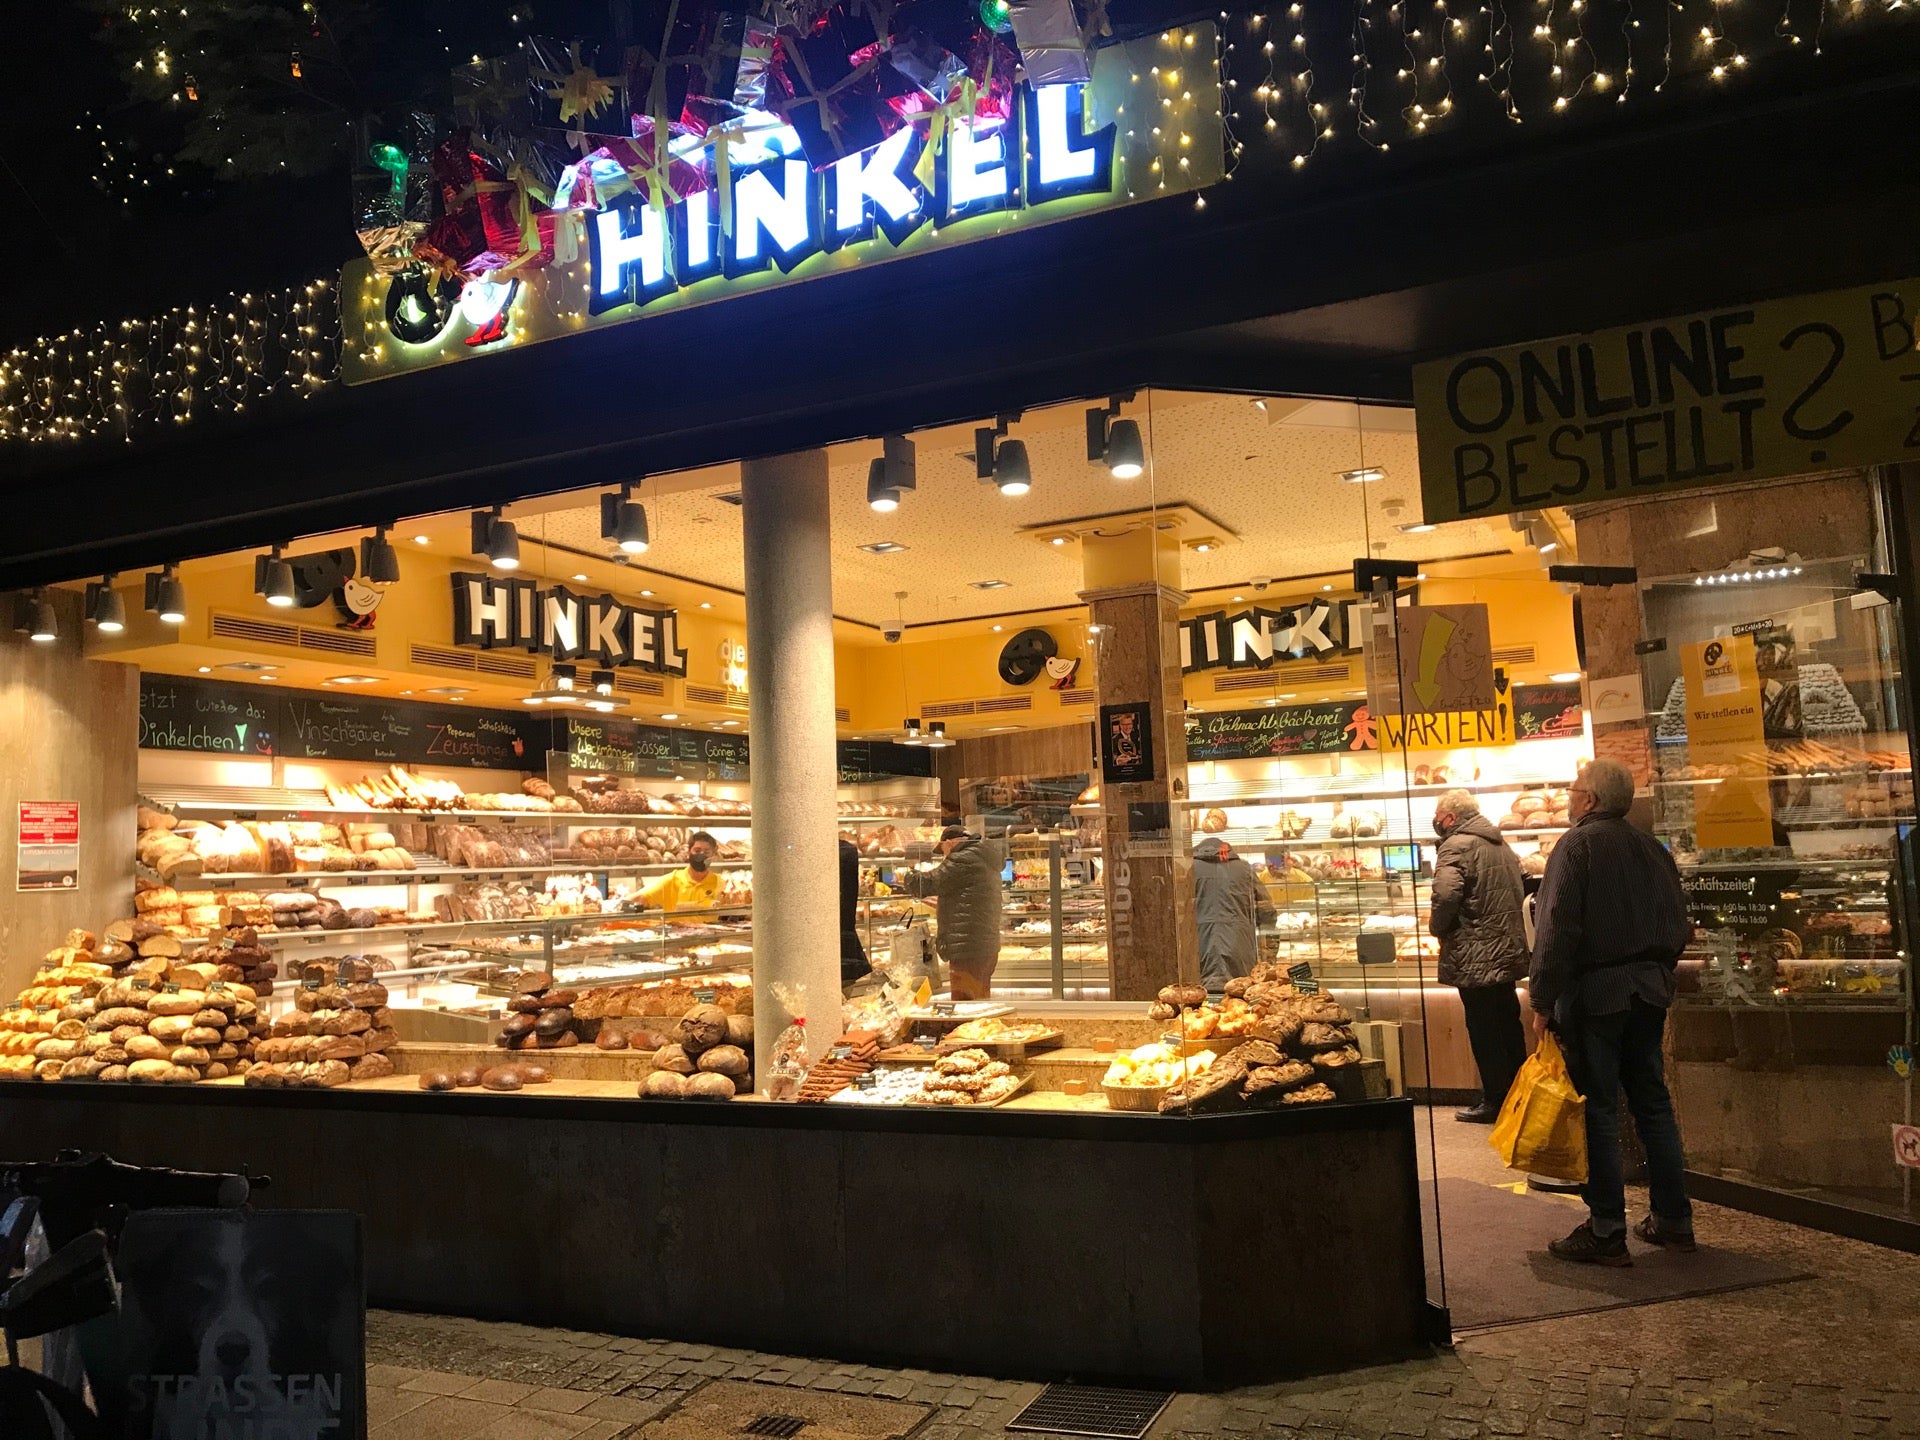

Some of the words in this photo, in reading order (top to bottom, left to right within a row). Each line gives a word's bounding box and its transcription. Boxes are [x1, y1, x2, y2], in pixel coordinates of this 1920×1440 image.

[592, 80, 1110, 312] HINKEL
[1445, 309, 1765, 434] ONLINE
[1453, 399, 1766, 515] BESTELLT
[454, 574, 686, 676] HINKEL
[1179, 590, 1413, 670] INK
[139, 687, 178, 709] etzt
[1694, 710, 1709, 720] Wir
[1711, 707, 1739, 718] stellen
[1740, 705, 1754, 714] ein
[569, 719, 603, 739] Unsere
[1383, 703, 1508, 748] WARTEN!
[705, 739, 736, 758] Gönnen
[128, 1371, 342, 1412] STRASSEN
